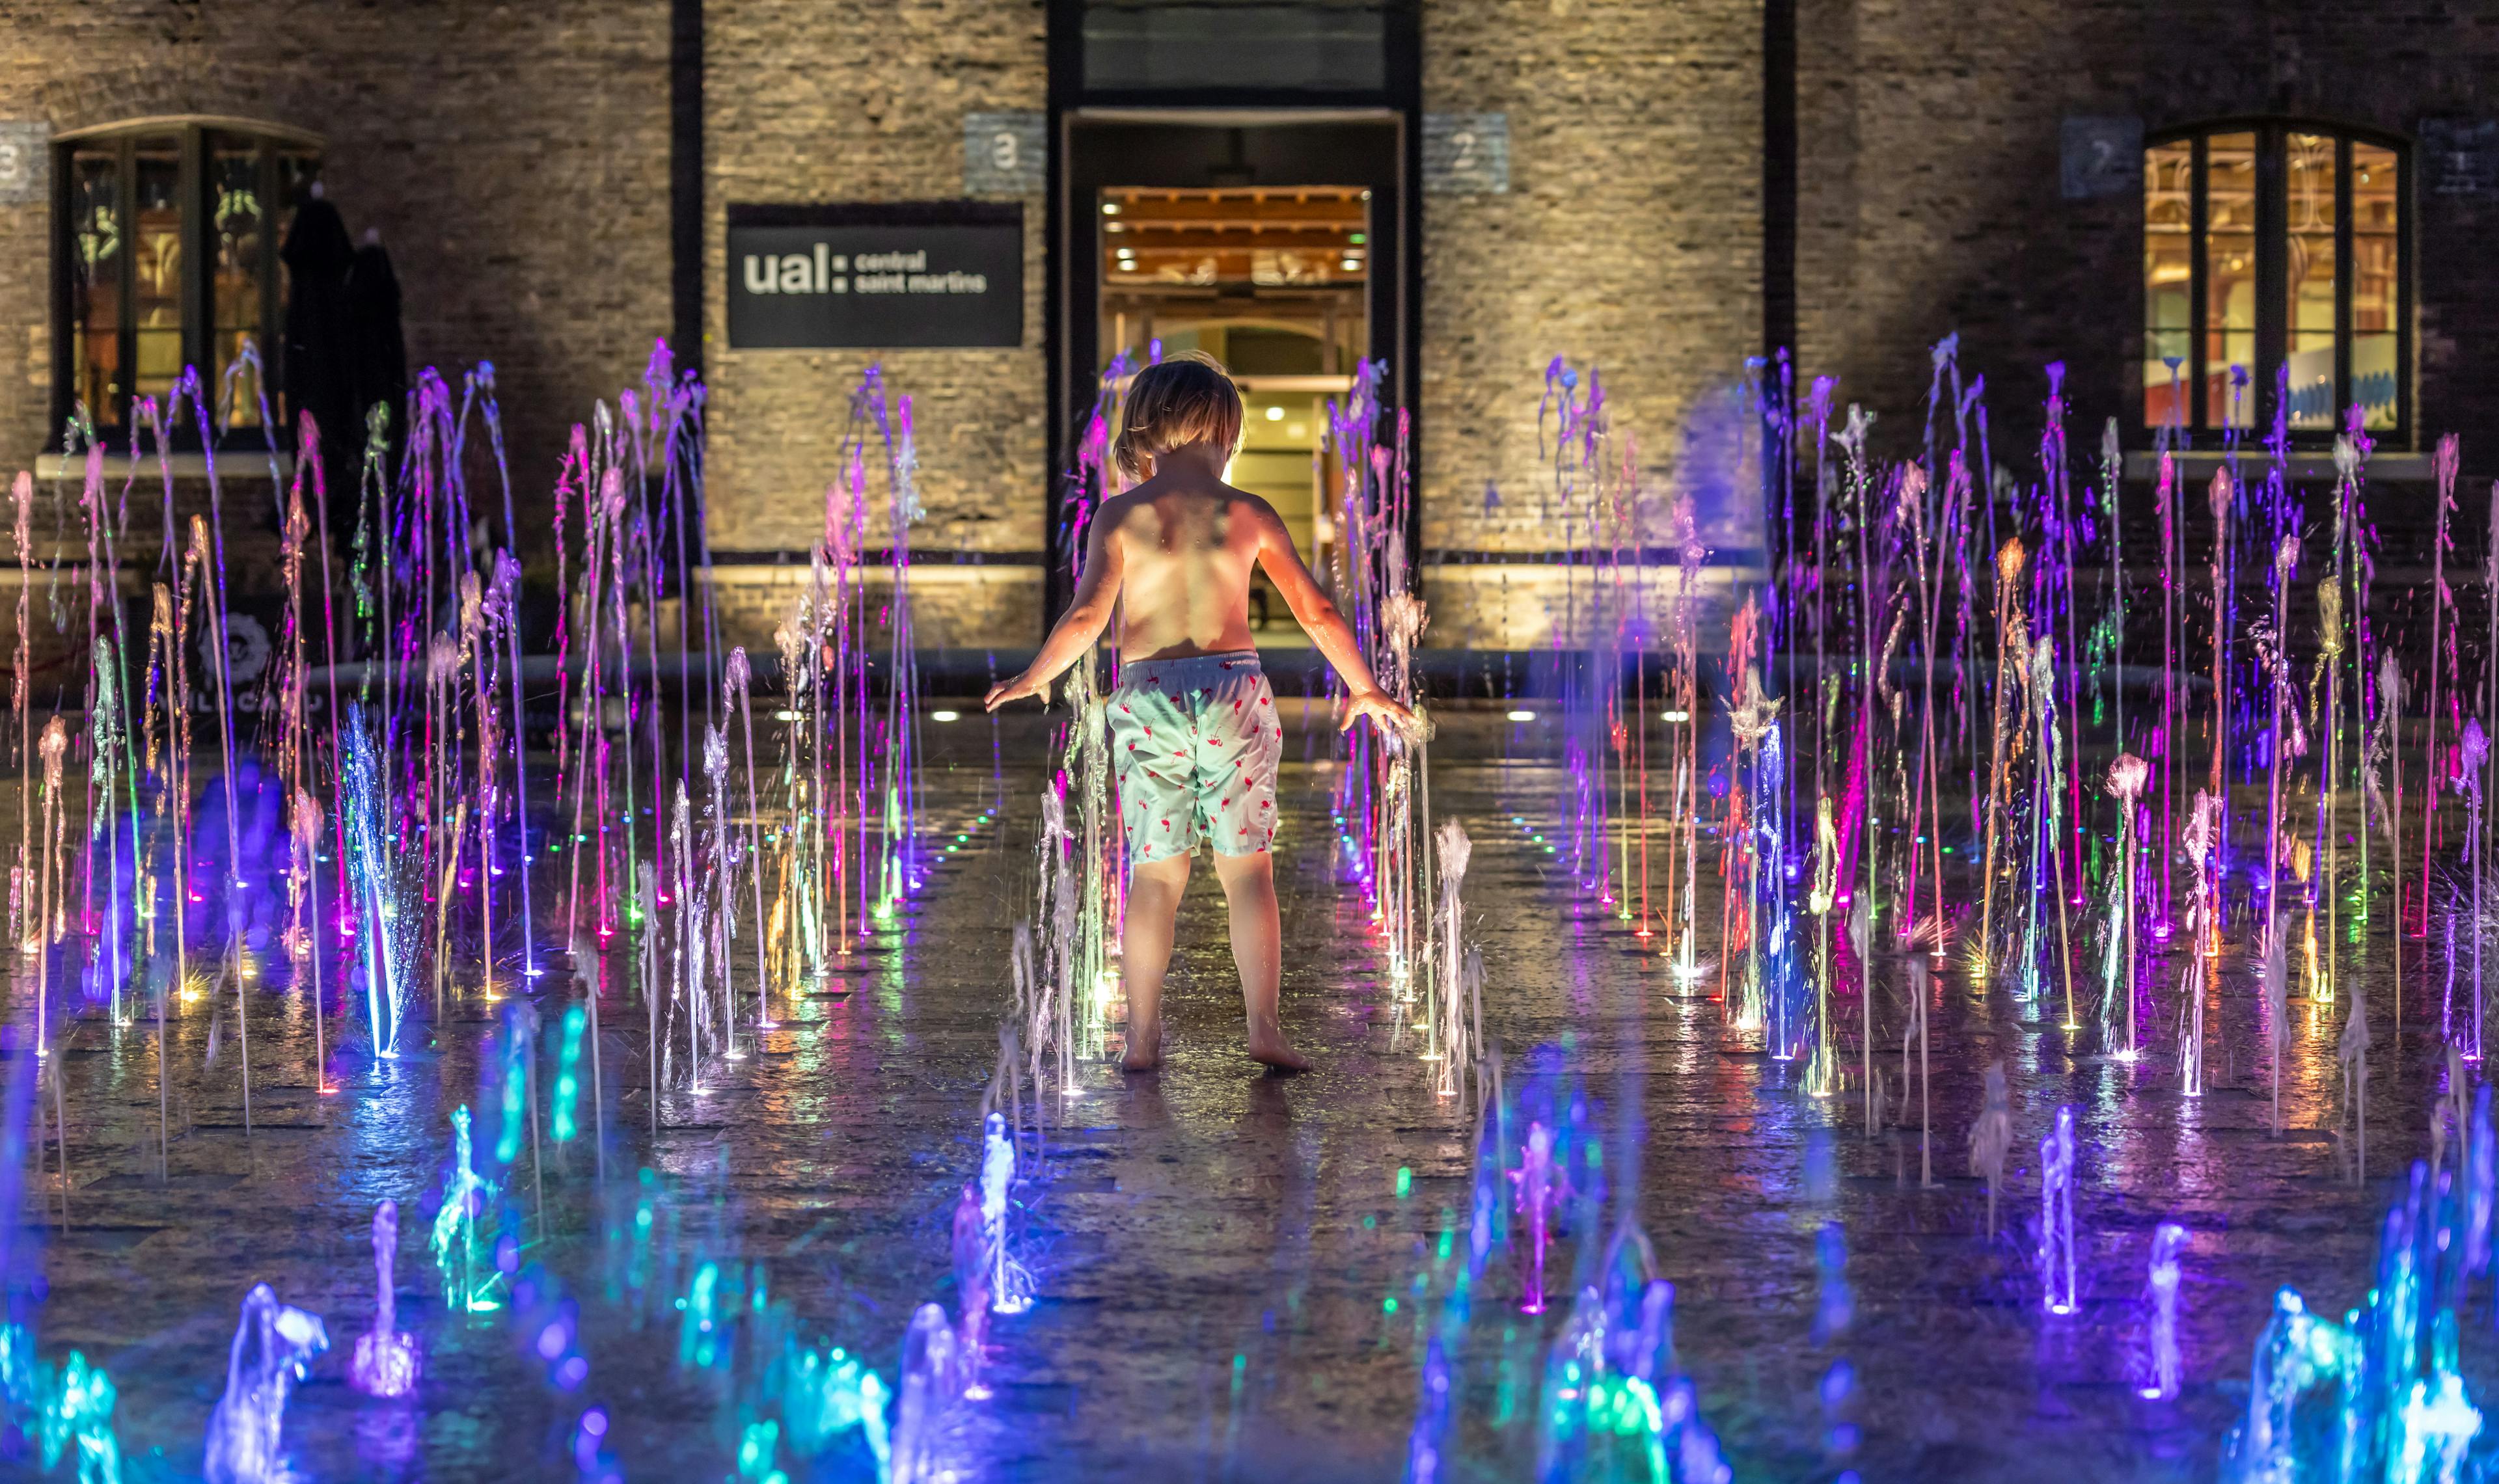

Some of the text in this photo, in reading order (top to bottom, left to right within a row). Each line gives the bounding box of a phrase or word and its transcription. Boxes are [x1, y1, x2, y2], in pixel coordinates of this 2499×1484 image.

[994, 132, 1018, 169] 3
[1452, 132, 1476, 168] 2
[743, 243, 848, 294] ual:
[854, 250, 927, 272] central
[854, 270, 987, 293] saint martins
